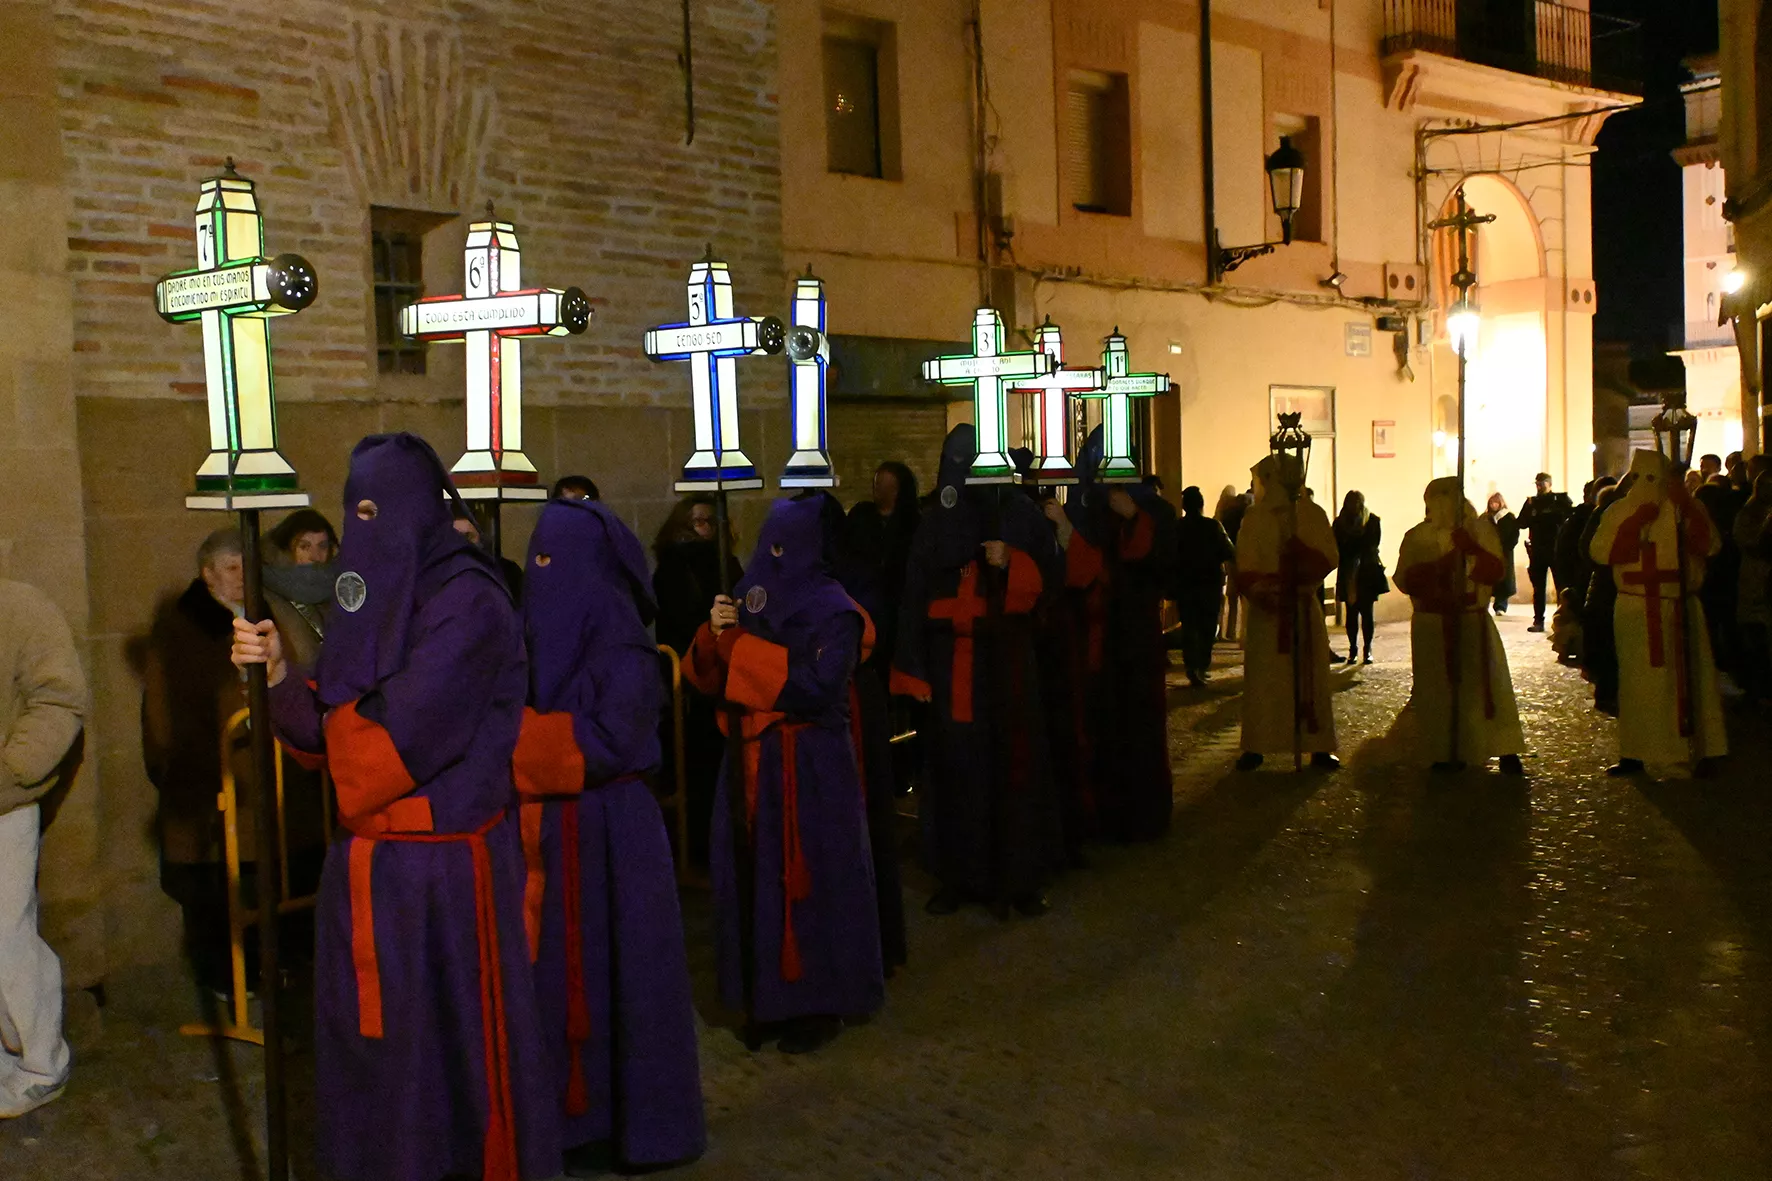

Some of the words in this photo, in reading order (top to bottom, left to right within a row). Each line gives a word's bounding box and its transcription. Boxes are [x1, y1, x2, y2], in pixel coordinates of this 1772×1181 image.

[167, 279, 187, 294] PADRE
[189, 277, 201, 289] MIO
[203, 276, 211, 288] EN
[213, 274, 225, 286] TUS
[226, 270, 250, 284] MANOS
[170, 292, 208, 308] ENCOMIENDO
[210, 291, 219, 302] MI
[220, 287, 249, 302] ESPIRITU
[426, 312, 449, 324] TODO
[452, 310, 475, 322] ESTA
[478, 307, 525, 320] CUMPLIDO
[676, 333, 702, 348] TENGO
[706, 331, 722, 345] SED
